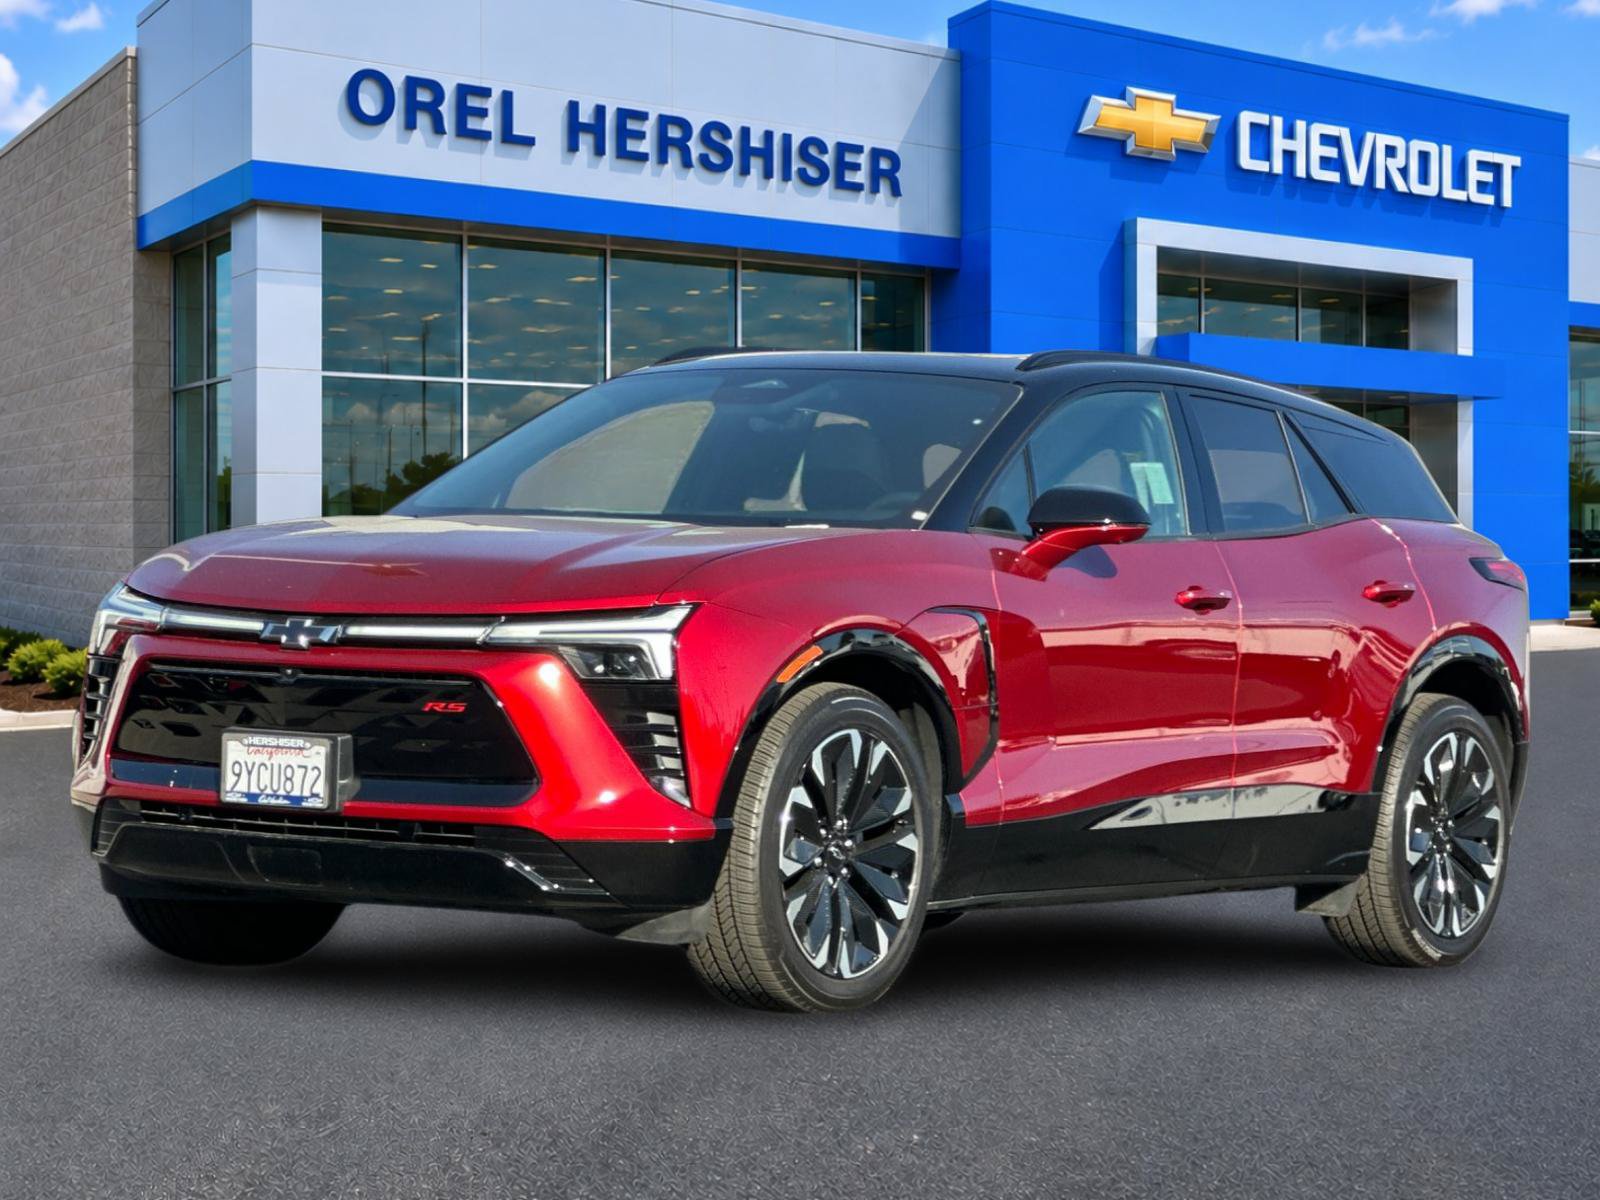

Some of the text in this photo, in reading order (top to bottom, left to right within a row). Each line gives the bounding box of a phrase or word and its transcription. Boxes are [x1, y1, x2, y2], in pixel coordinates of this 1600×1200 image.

[346, 68, 902, 197] OREL HERSHISER
[1238, 110, 1522, 208] CHEVROLET
[422, 702, 468, 713] RS
[248, 736, 305, 747] HERSHISER
[231, 761, 321, 796] 9YCU872
